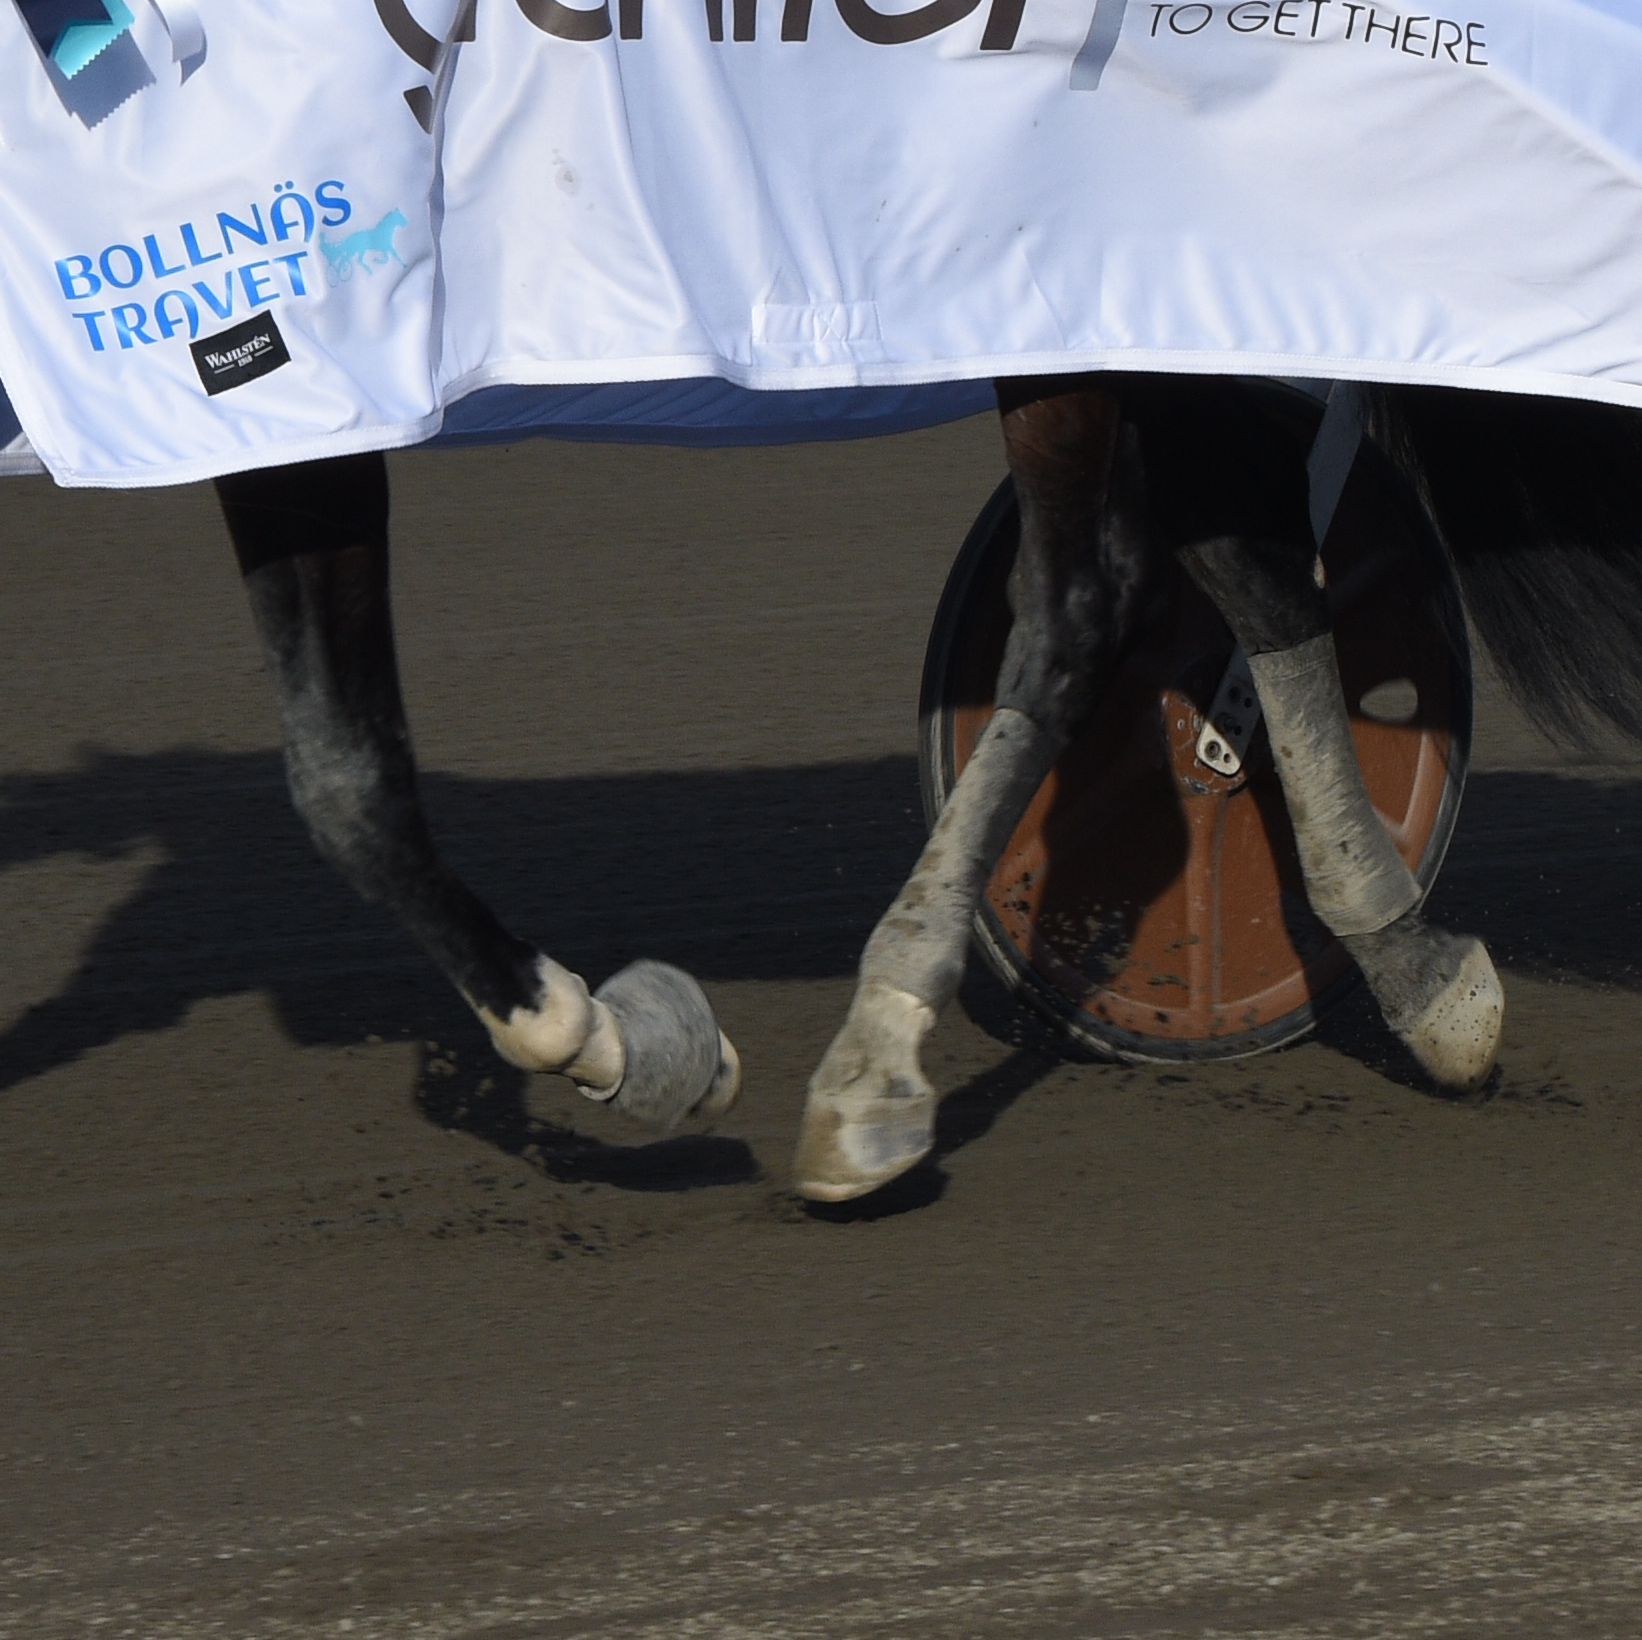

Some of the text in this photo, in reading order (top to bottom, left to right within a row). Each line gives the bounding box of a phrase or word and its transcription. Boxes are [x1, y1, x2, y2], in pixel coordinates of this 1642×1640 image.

[1149, 3, 1214, 38] TO
[1341, 1, 1489, 66] THERE
[54, 179, 353, 301] BOLLNÄS
[71, 252, 309, 354] TRAVET
